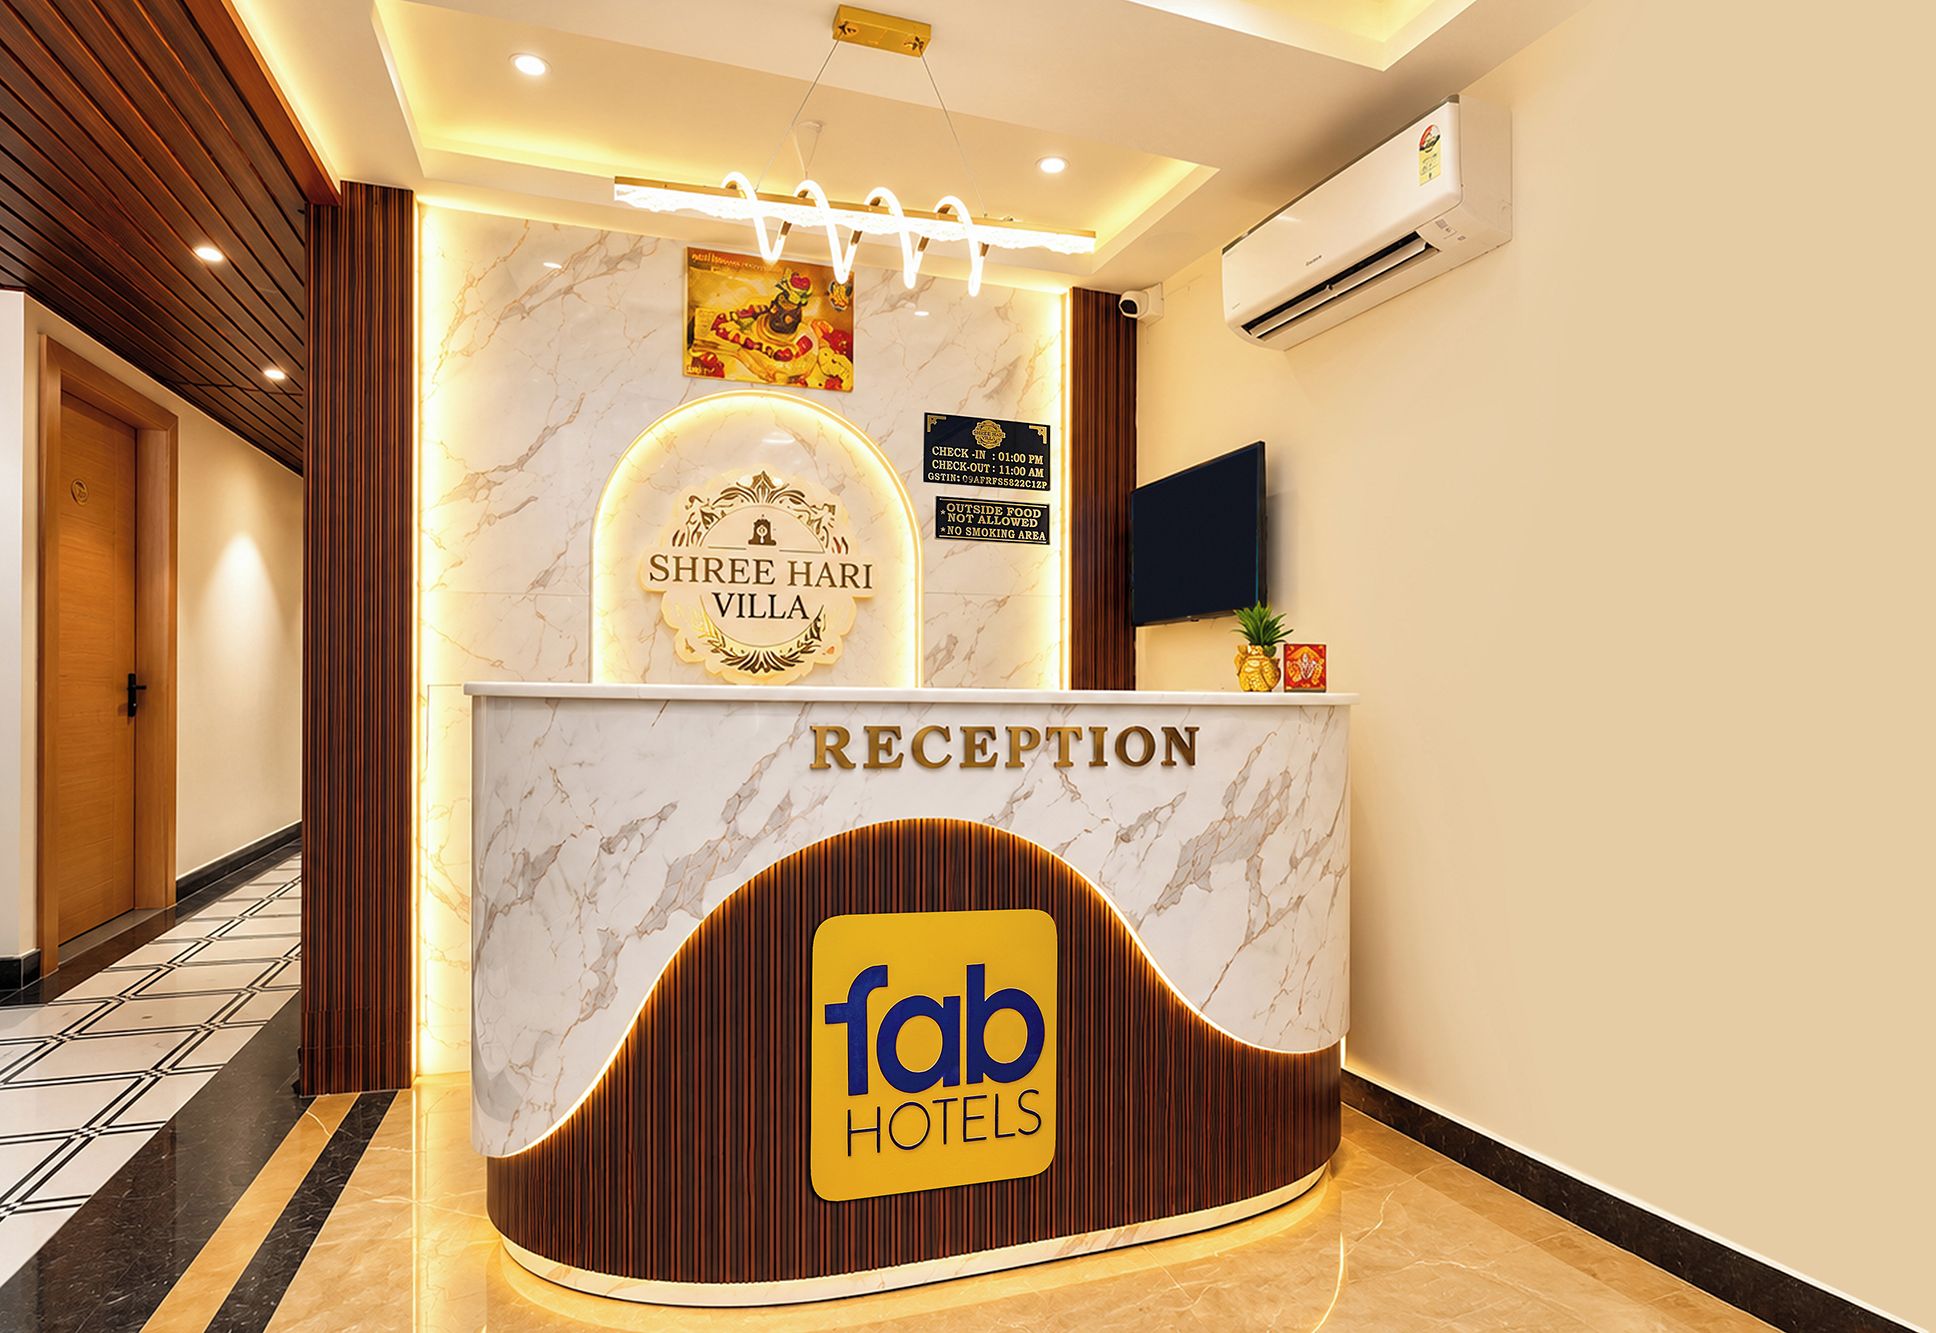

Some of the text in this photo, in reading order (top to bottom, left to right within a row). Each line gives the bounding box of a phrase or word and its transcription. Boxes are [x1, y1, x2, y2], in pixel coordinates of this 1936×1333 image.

[931, 446, 969, 458] CHECK
[998, 452, 1026, 463] 01:00
[1028, 454, 1044, 465] PM
[927, 472, 960, 482] GSTIN:
[931, 459, 990, 473] CHECK-OUT
[999, 465, 1026, 476] 11:00
[1028, 467, 1044, 478] AM
[946, 503, 1042, 518] OUTSIDE FOOD
[947, 513, 1038, 528] NOT ALLOWED
[947, 525, 1047, 541] NO SMOKING AREA
[649, 554, 873, 589] SHREE HARI
[711, 592, 810, 620] VILLA
[809, 725, 1200, 770] RECEPTION
[825, 963, 1045, 1096] fab
[848, 1089, 1042, 1157] HOTELS
